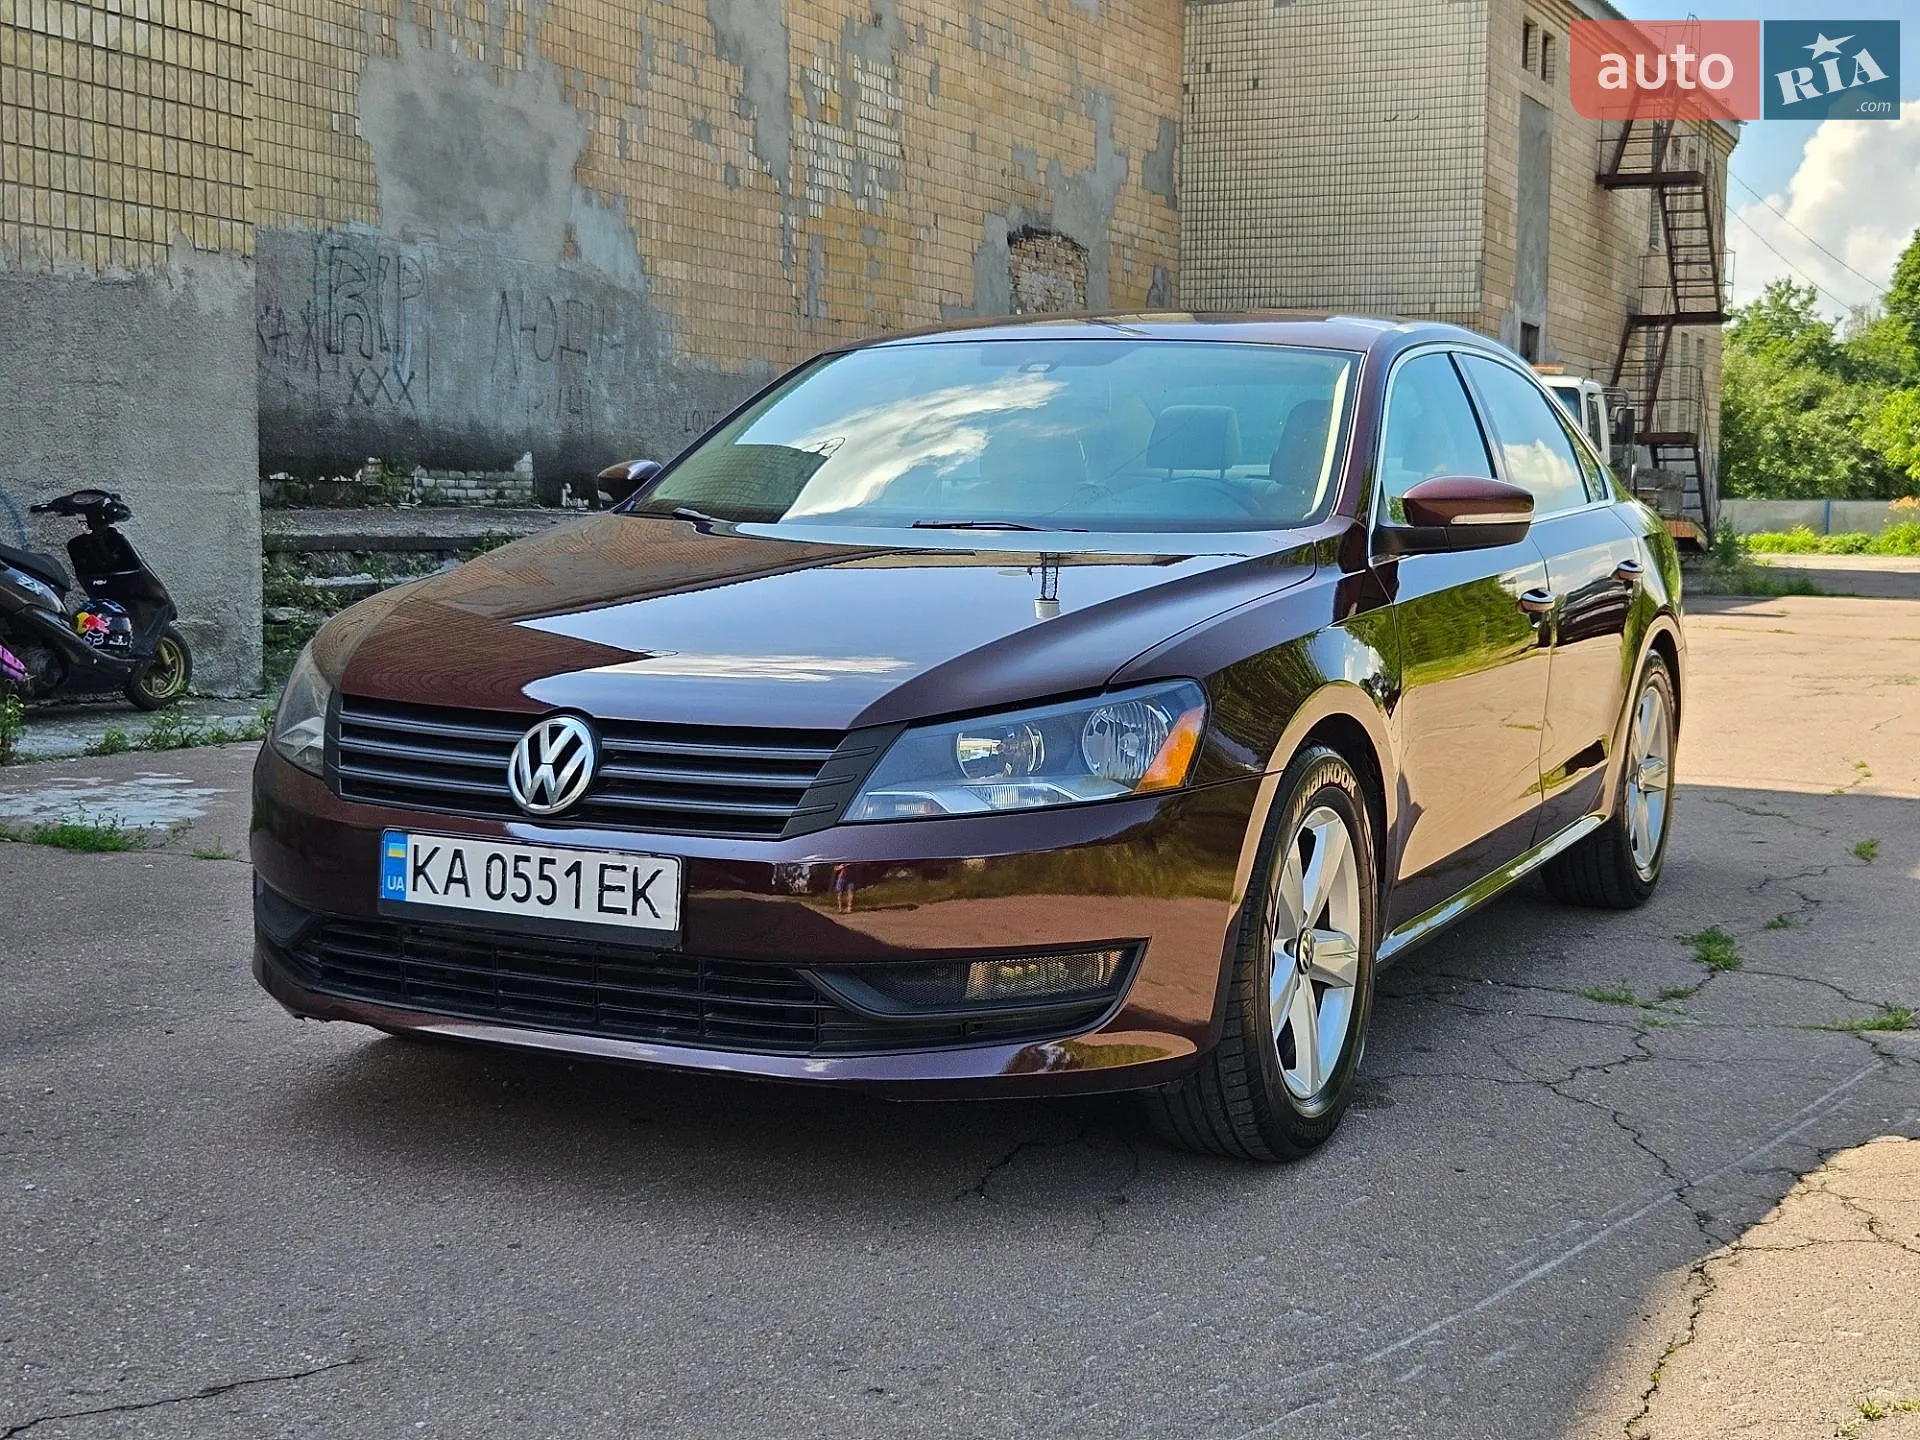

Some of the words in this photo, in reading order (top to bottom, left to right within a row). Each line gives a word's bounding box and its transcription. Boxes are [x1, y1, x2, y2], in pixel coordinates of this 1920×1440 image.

[387, 875, 405, 891] UA
[412, 844, 471, 898] KA
[485, 852, 582, 909] 0551
[598, 863, 664, 919] EK
